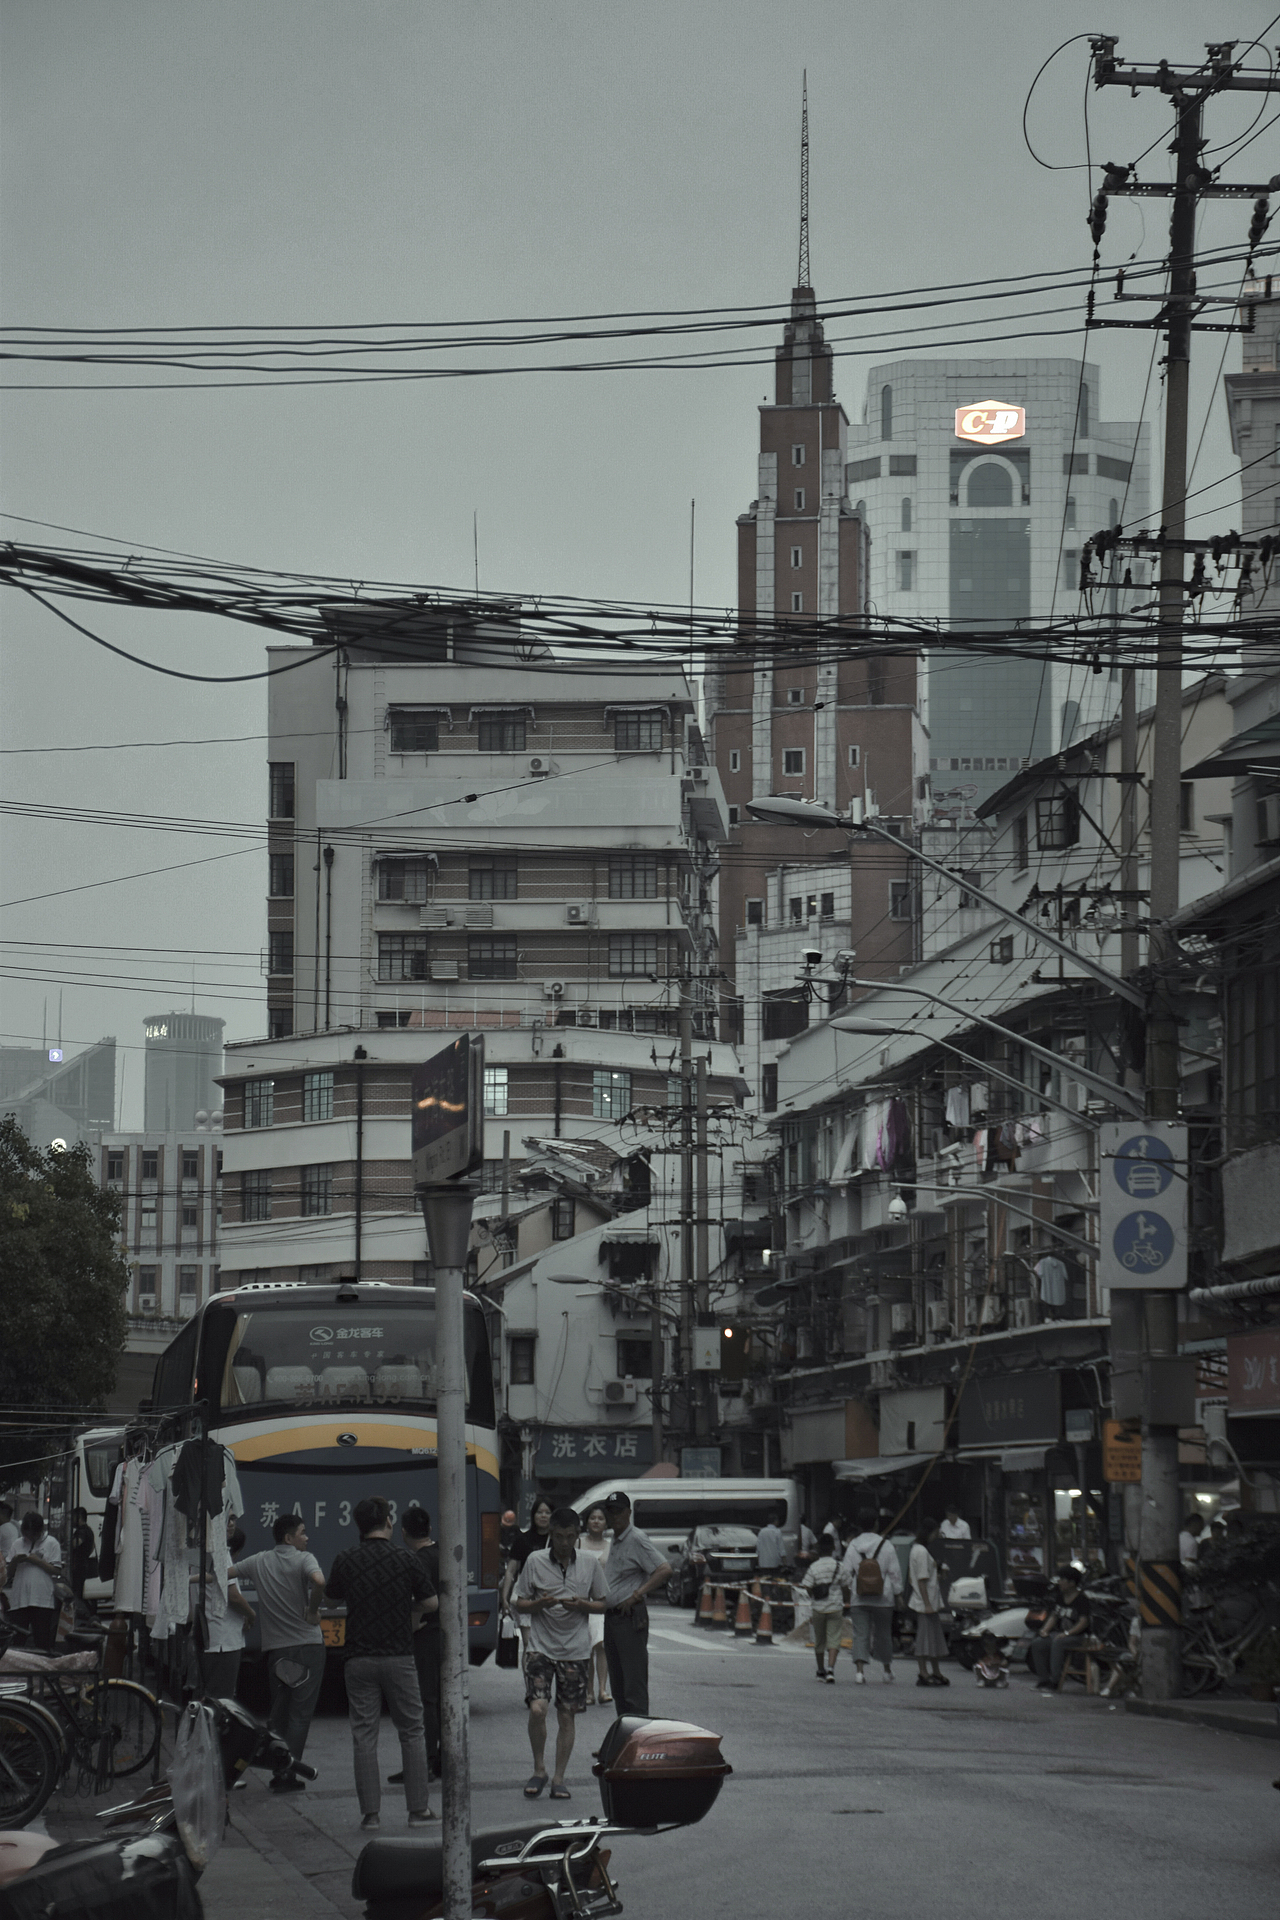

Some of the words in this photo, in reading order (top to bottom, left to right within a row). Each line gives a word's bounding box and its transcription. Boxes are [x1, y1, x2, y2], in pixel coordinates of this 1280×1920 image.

[335, 1327, 385, 1340] 金龙客车
[310, 1350, 385, 1359] 中国客车专家
[551, 1433, 639, 1459] 洗衣店
